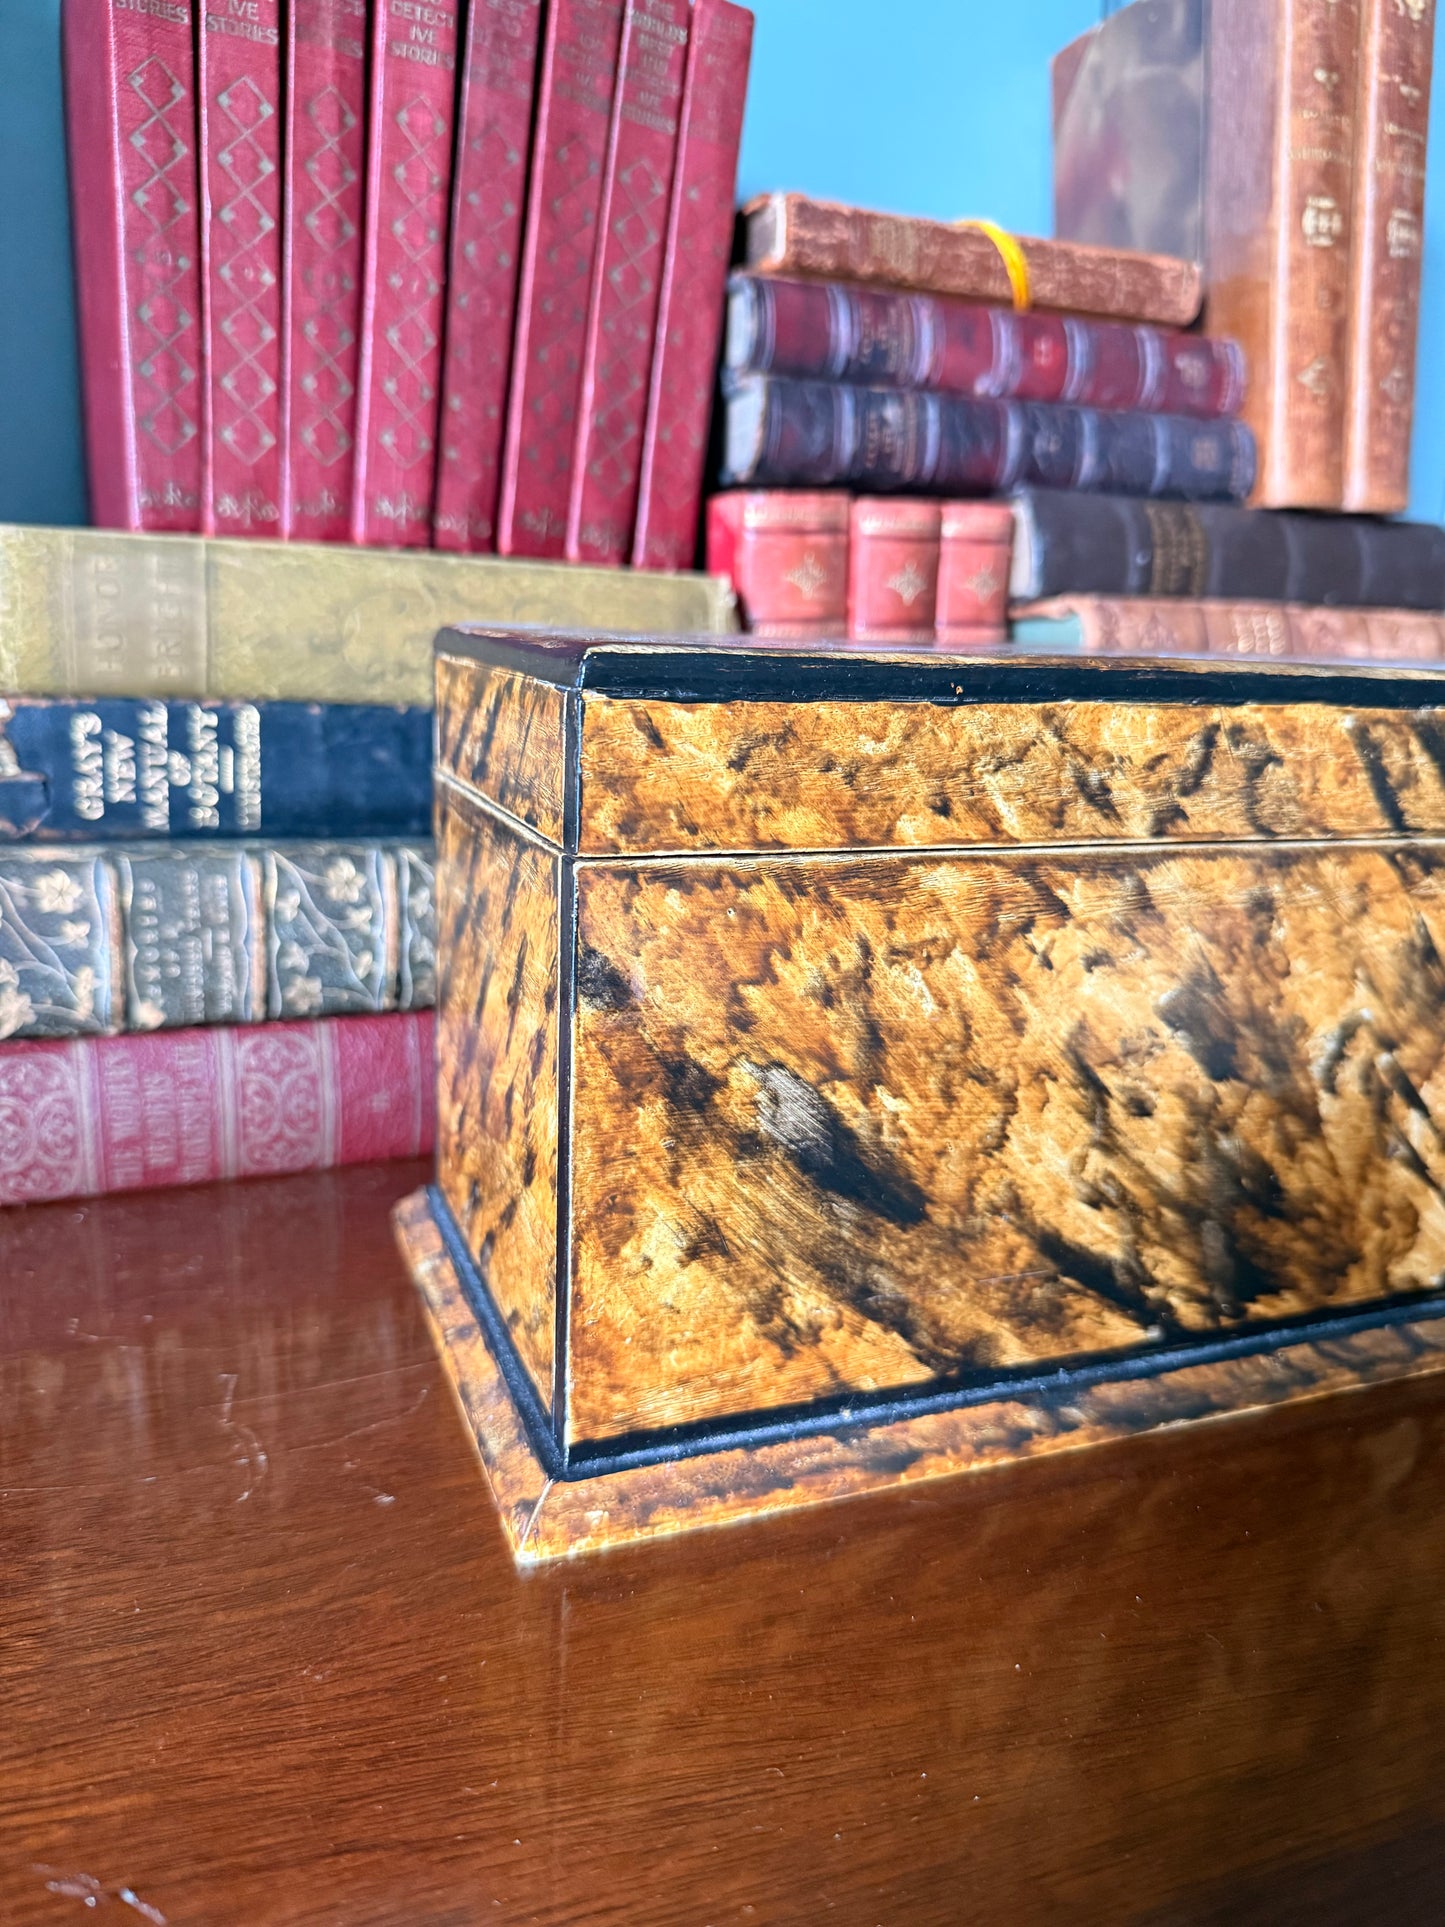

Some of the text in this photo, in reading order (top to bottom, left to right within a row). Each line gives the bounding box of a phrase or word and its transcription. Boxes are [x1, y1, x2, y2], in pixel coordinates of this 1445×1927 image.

[206, 13, 279, 45] STORIES
[390, 0, 454, 28] DETECT
[390, 41, 455, 70] STORIES
[102, 728, 136, 804] NEW
[136, 700, 170, 832] MANUAL
[167, 749, 192, 787] OF
[187, 703, 220, 830] BOTANY
